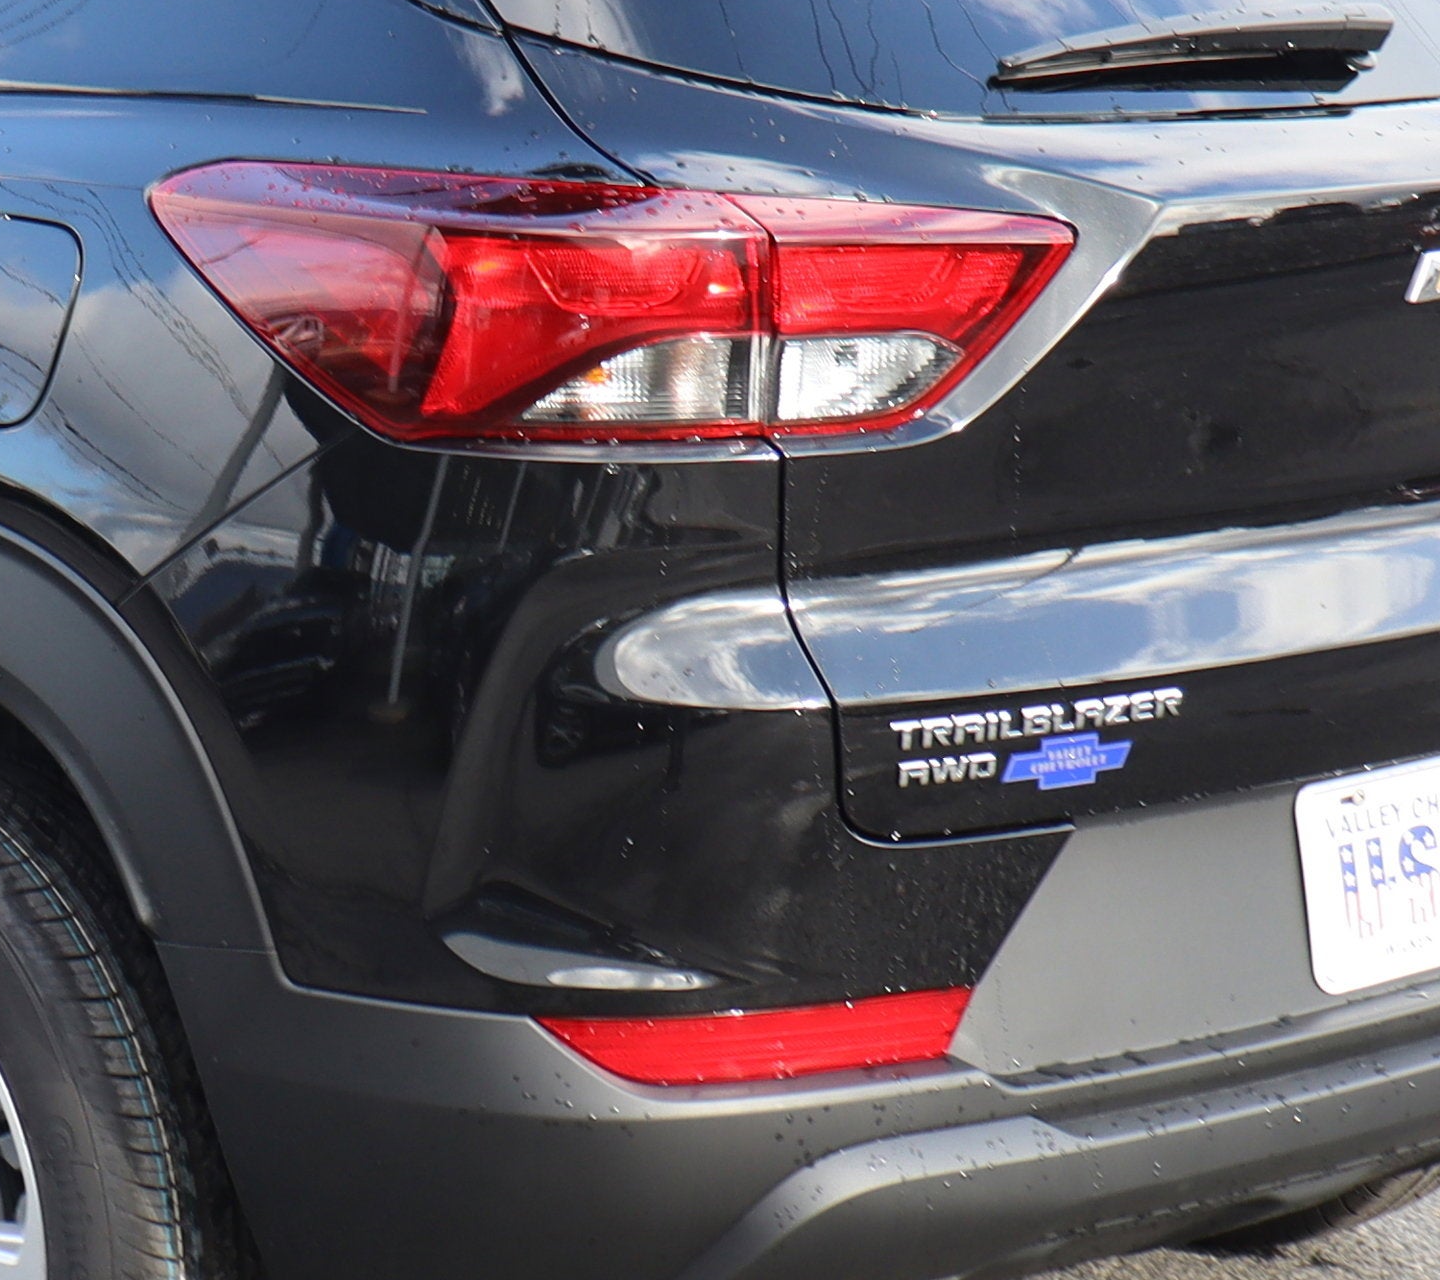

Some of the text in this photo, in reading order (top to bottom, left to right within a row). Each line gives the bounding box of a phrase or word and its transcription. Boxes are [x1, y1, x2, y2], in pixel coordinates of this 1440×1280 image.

[889, 686, 1184, 750] TRAILBLAZER
[897, 752, 998, 788] AWD
[1325, 803, 1402, 839] VALLEY
